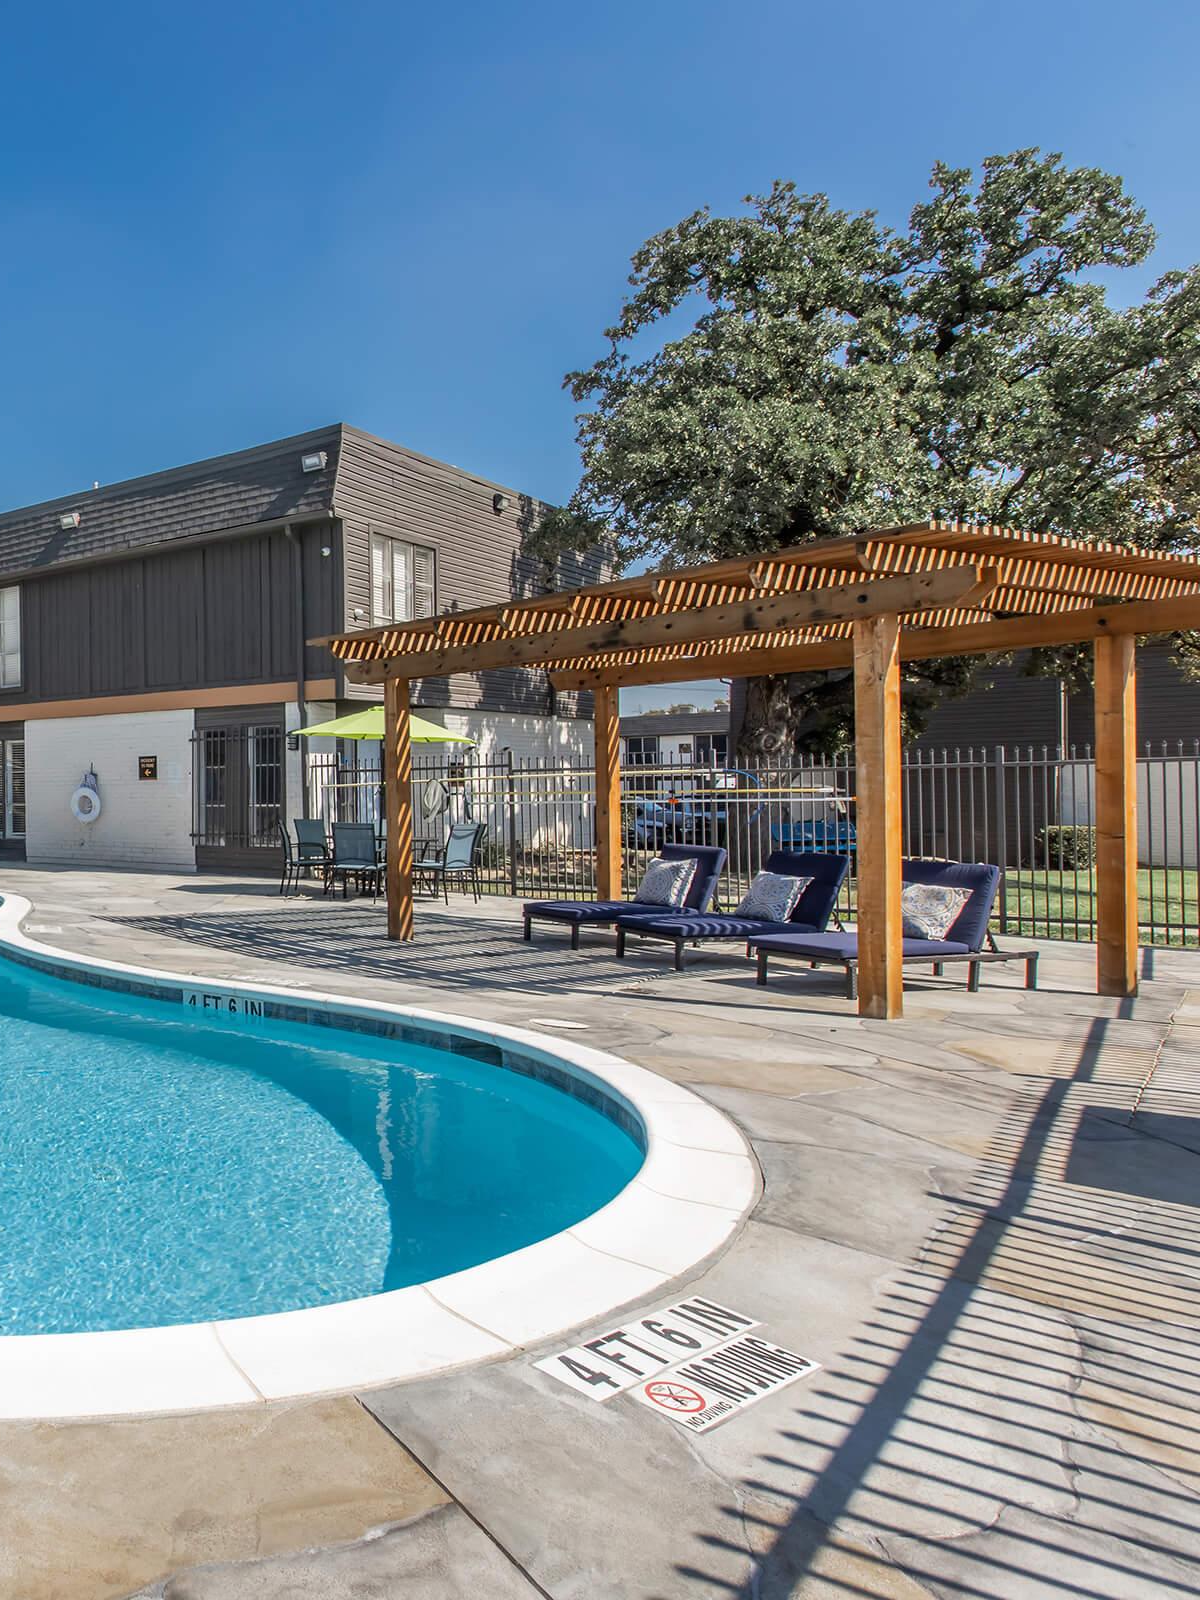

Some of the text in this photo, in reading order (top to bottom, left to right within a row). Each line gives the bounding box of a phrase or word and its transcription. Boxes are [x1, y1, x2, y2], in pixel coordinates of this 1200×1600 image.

[203, 994, 222, 1010] FT
[228, 998, 237, 1013] 6
[244, 999, 262, 1017] IN
[557, 1298, 753, 1389] 4 FT 6 IN
[676, 1337, 811, 1403] NO DIVING
[686, 1401, 733, 1429] NO DIVING
